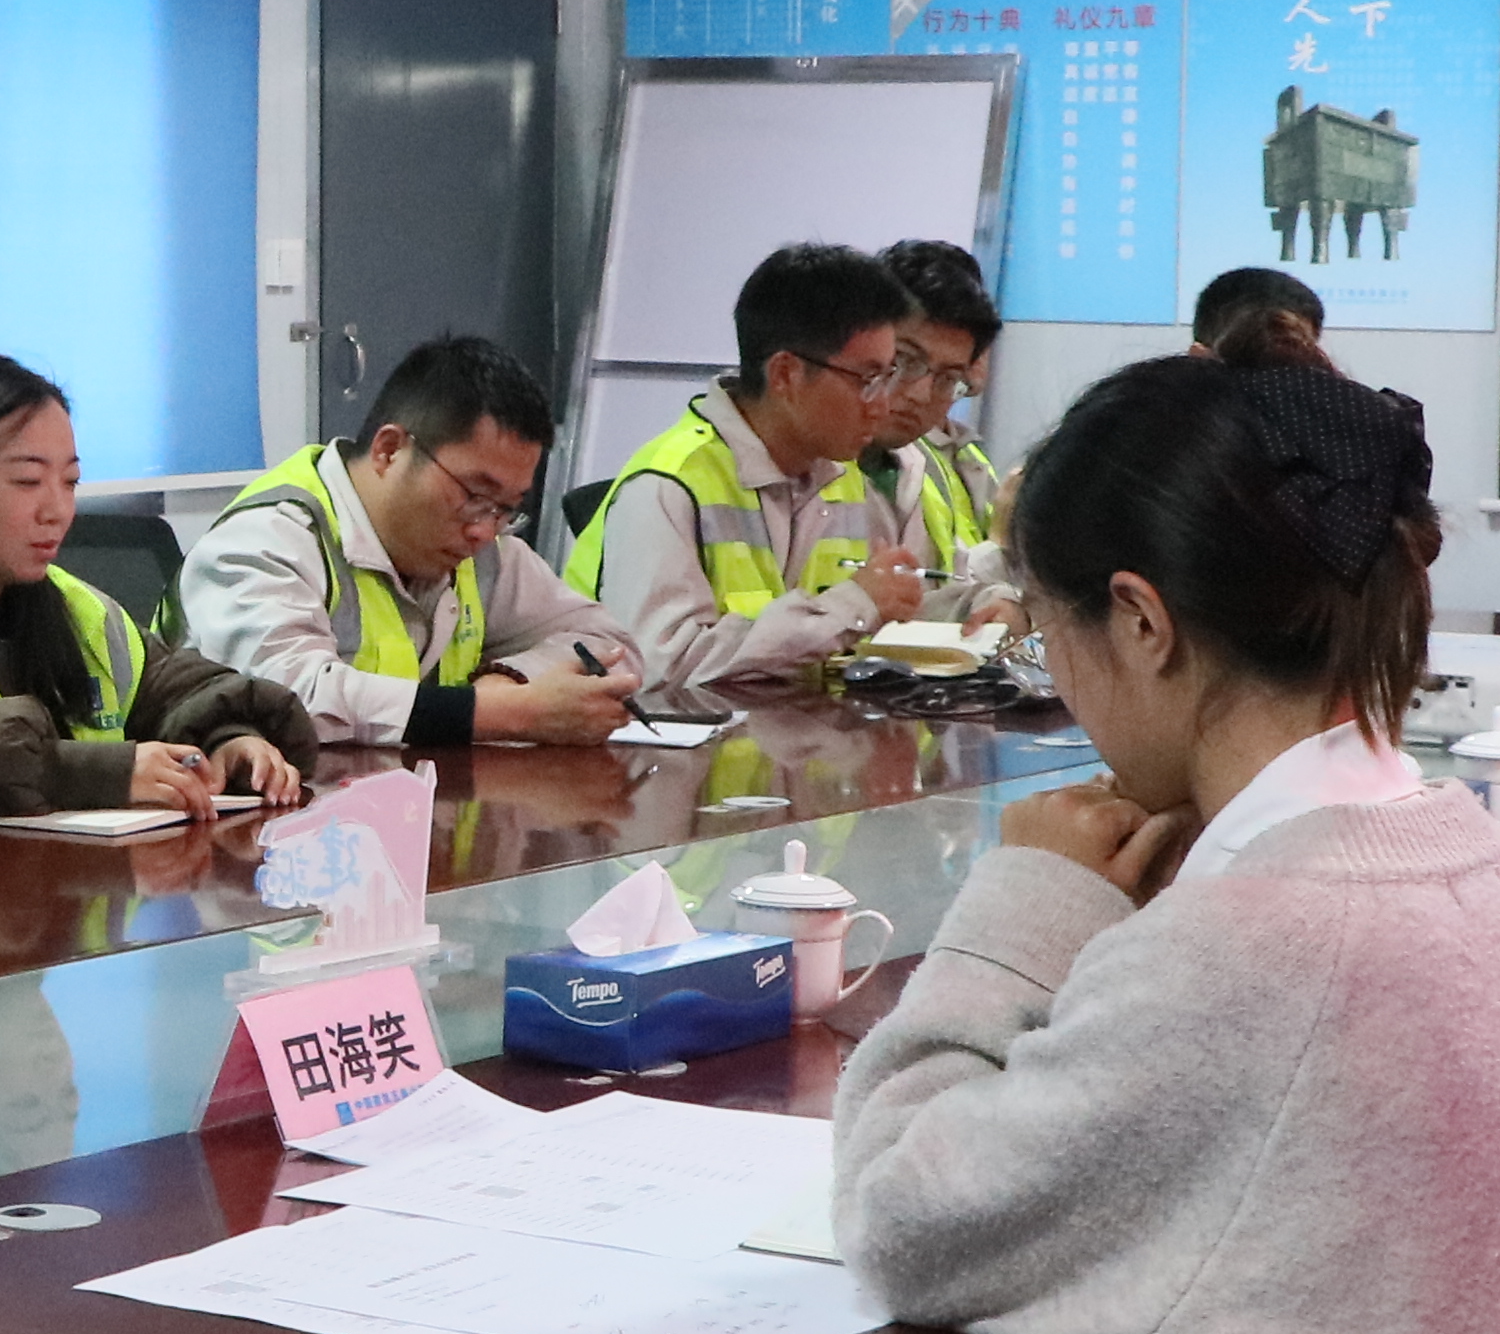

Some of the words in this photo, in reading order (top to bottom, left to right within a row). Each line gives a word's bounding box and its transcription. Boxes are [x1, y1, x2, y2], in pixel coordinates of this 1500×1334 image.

[922, 7, 1021, 33] 行为十典
[566, 976, 619, 1003] Tempo
[281, 1010, 421, 1102] 田海笑
